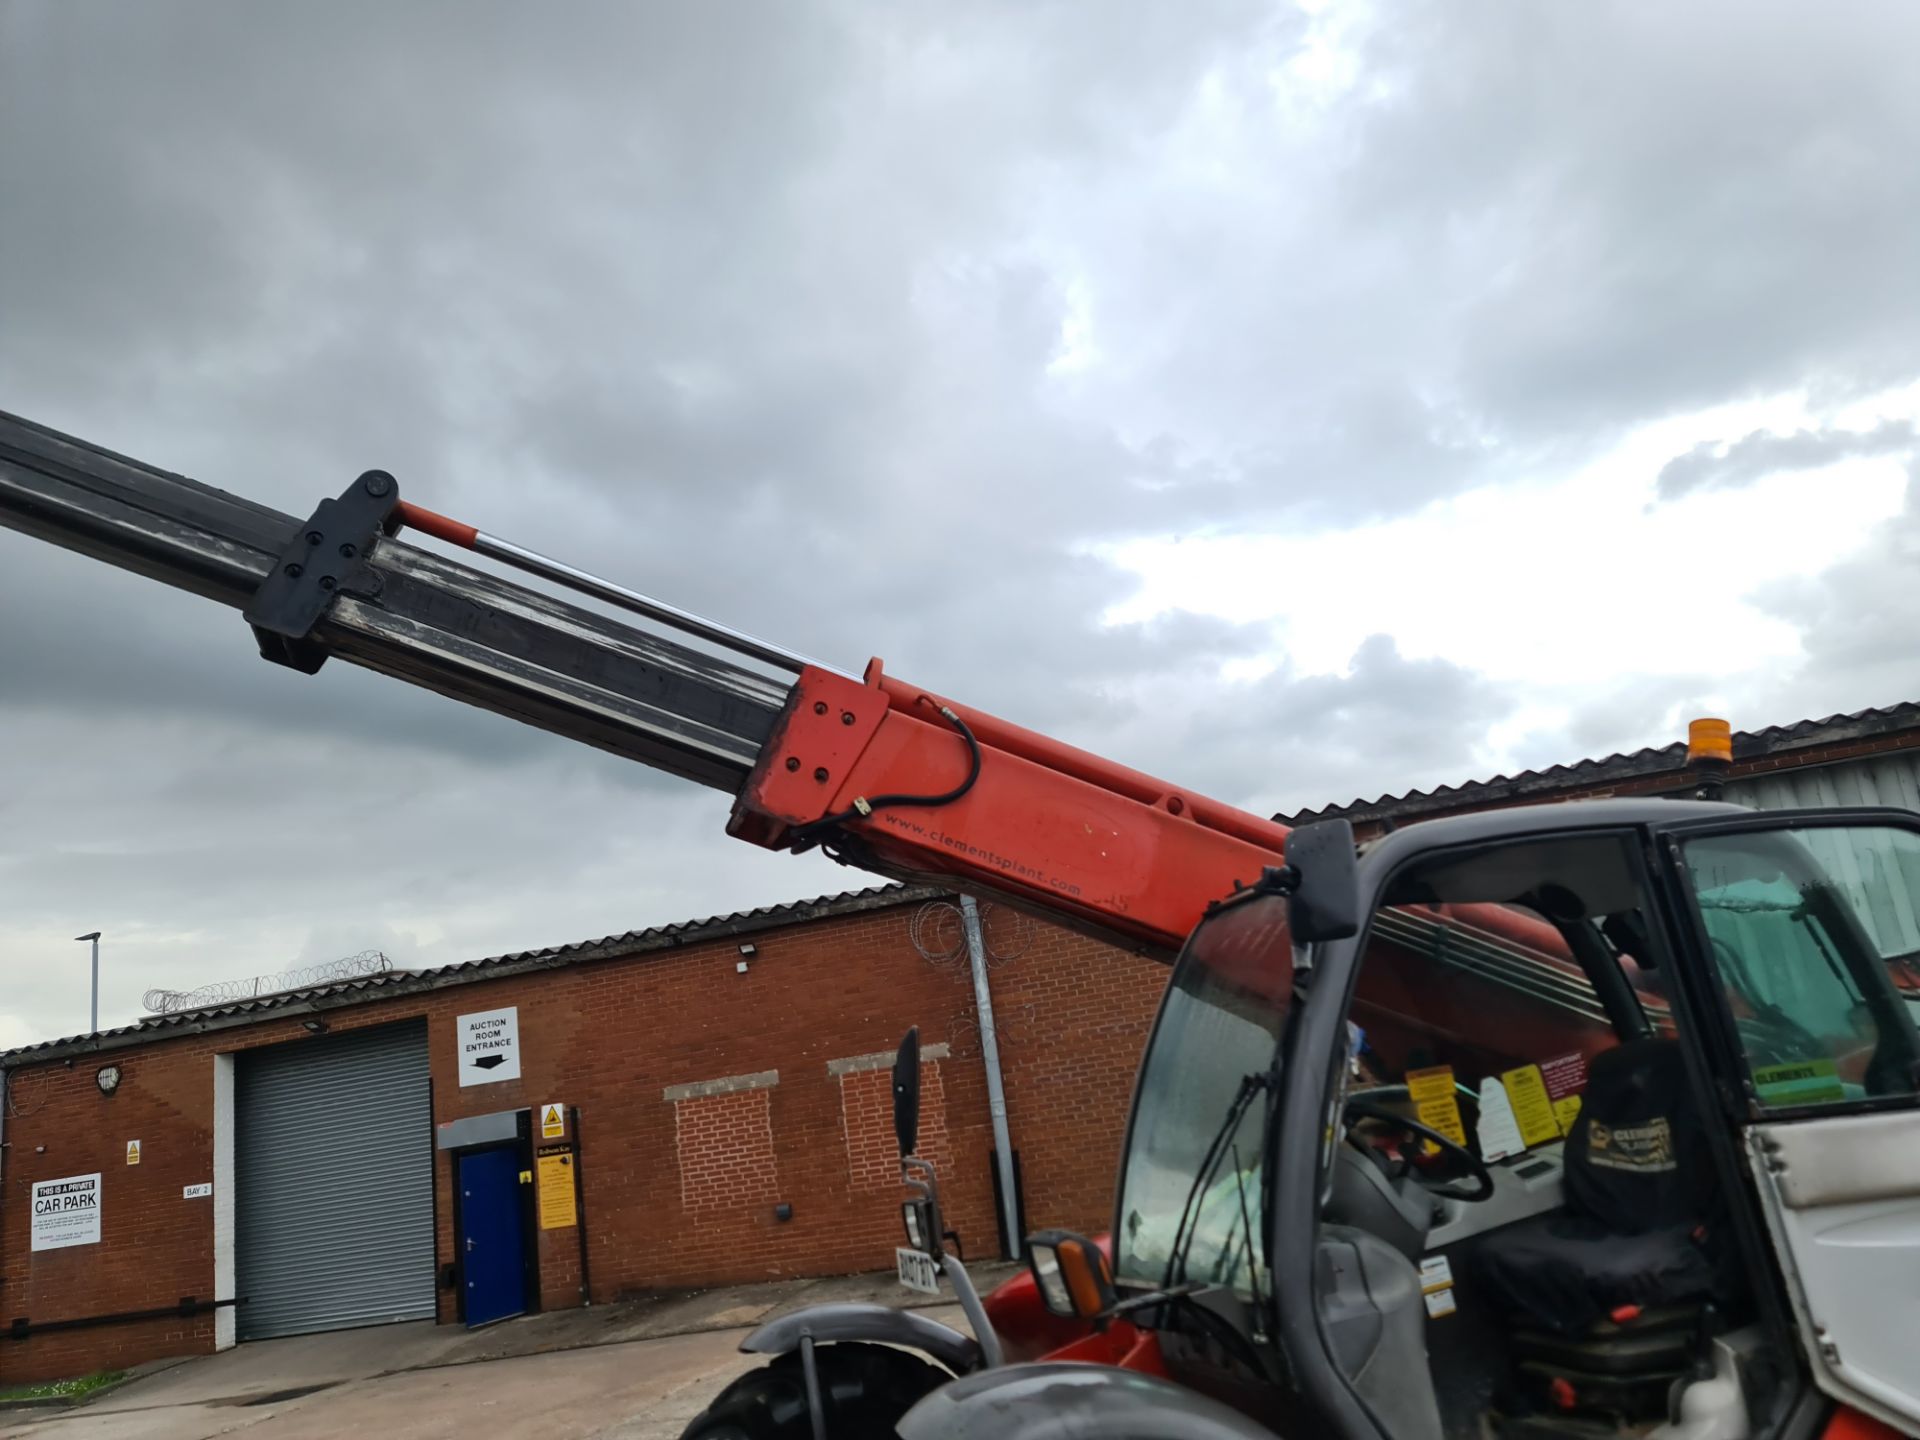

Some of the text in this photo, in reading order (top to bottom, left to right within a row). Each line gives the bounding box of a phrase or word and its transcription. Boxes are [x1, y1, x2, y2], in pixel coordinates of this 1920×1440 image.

[885, 813, 1082, 896] www.clementsplant.com
[470, 1018, 507, 1031] AUCTION
[475, 1030, 501, 1040] ROOM
[466, 1038, 511, 1052] ENTRANCE
[40, 1181, 93, 1196] THIS IS A PRIVATE
[186, 1186, 201, 1196] BAY
[35, 1192, 96, 1213] CAR PARK
